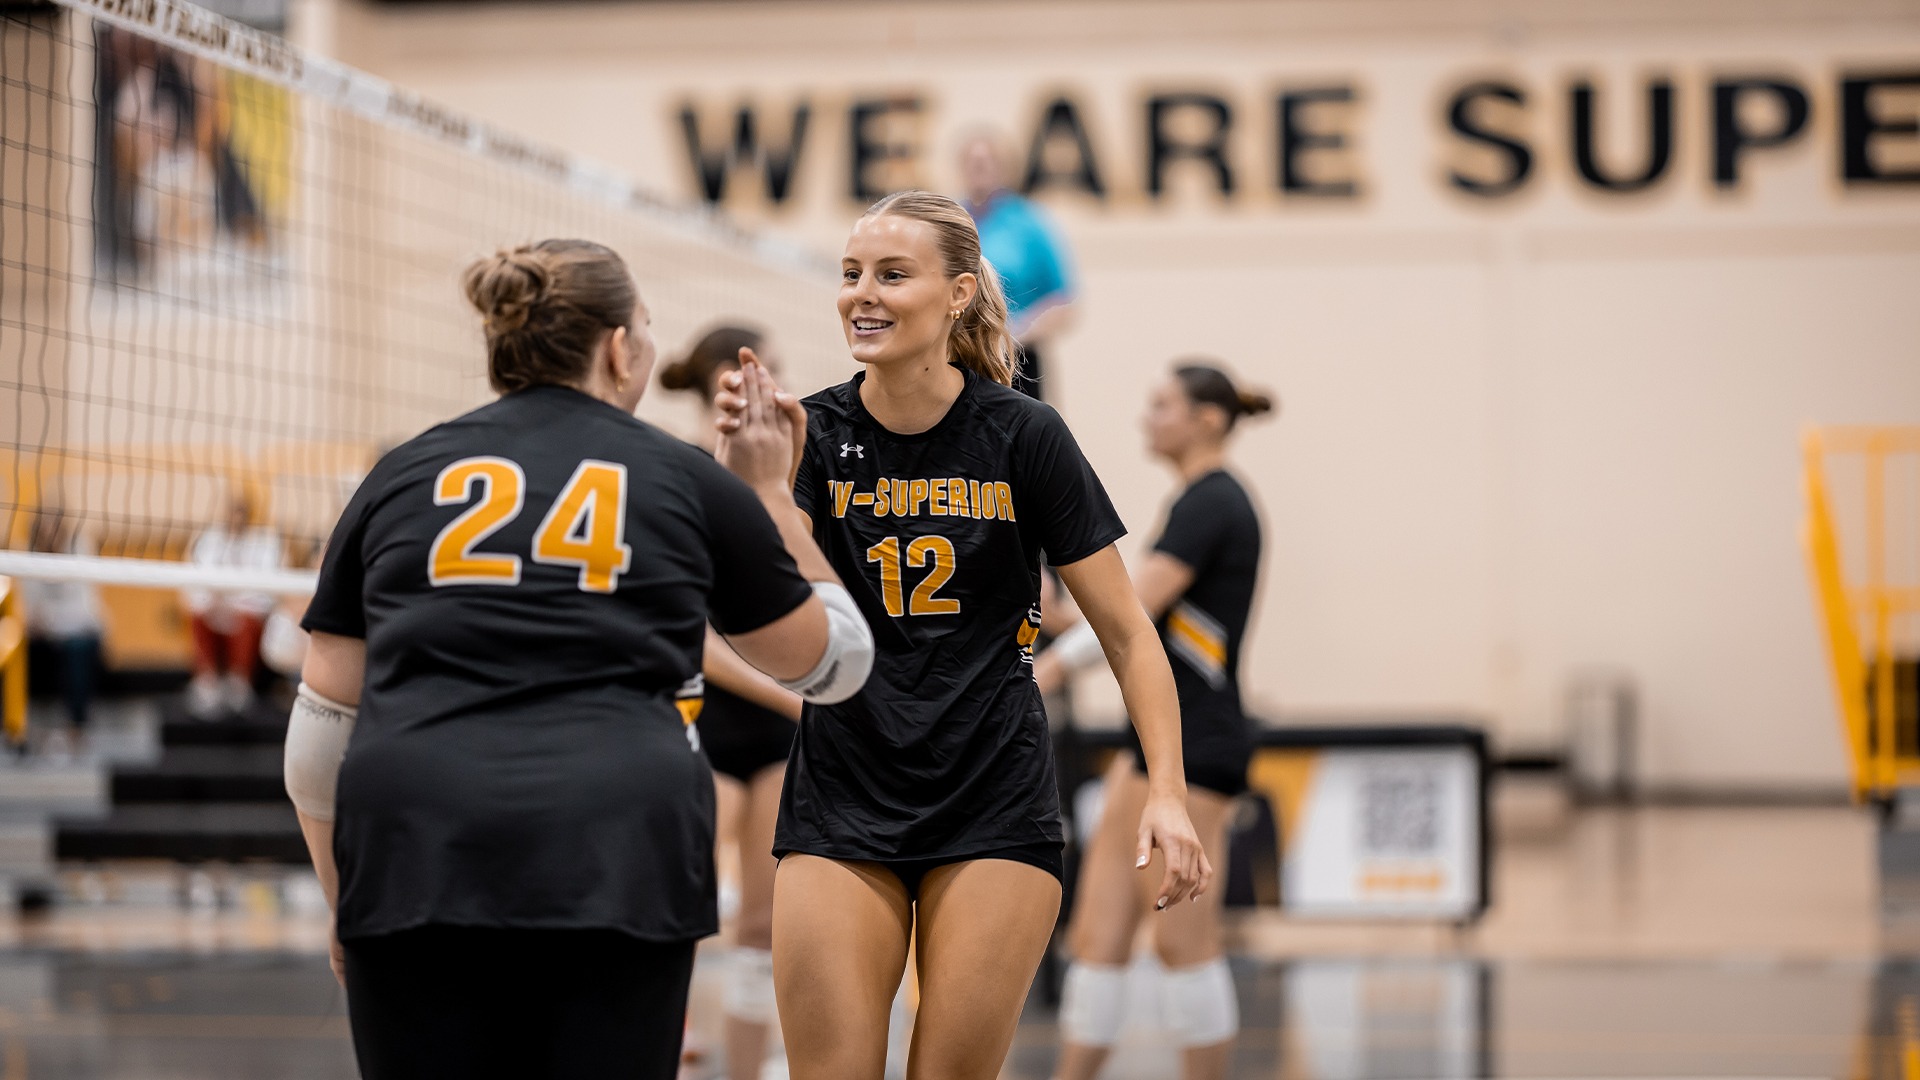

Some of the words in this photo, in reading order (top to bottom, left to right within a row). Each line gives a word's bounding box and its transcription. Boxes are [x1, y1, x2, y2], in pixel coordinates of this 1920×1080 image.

[681, 98, 927, 207] WE
[1019, 84, 1361, 203] ARE
[1444, 73, 1920, 195] SUPE
[428, 456, 631, 594] 24
[866, 535, 961, 618] 12
